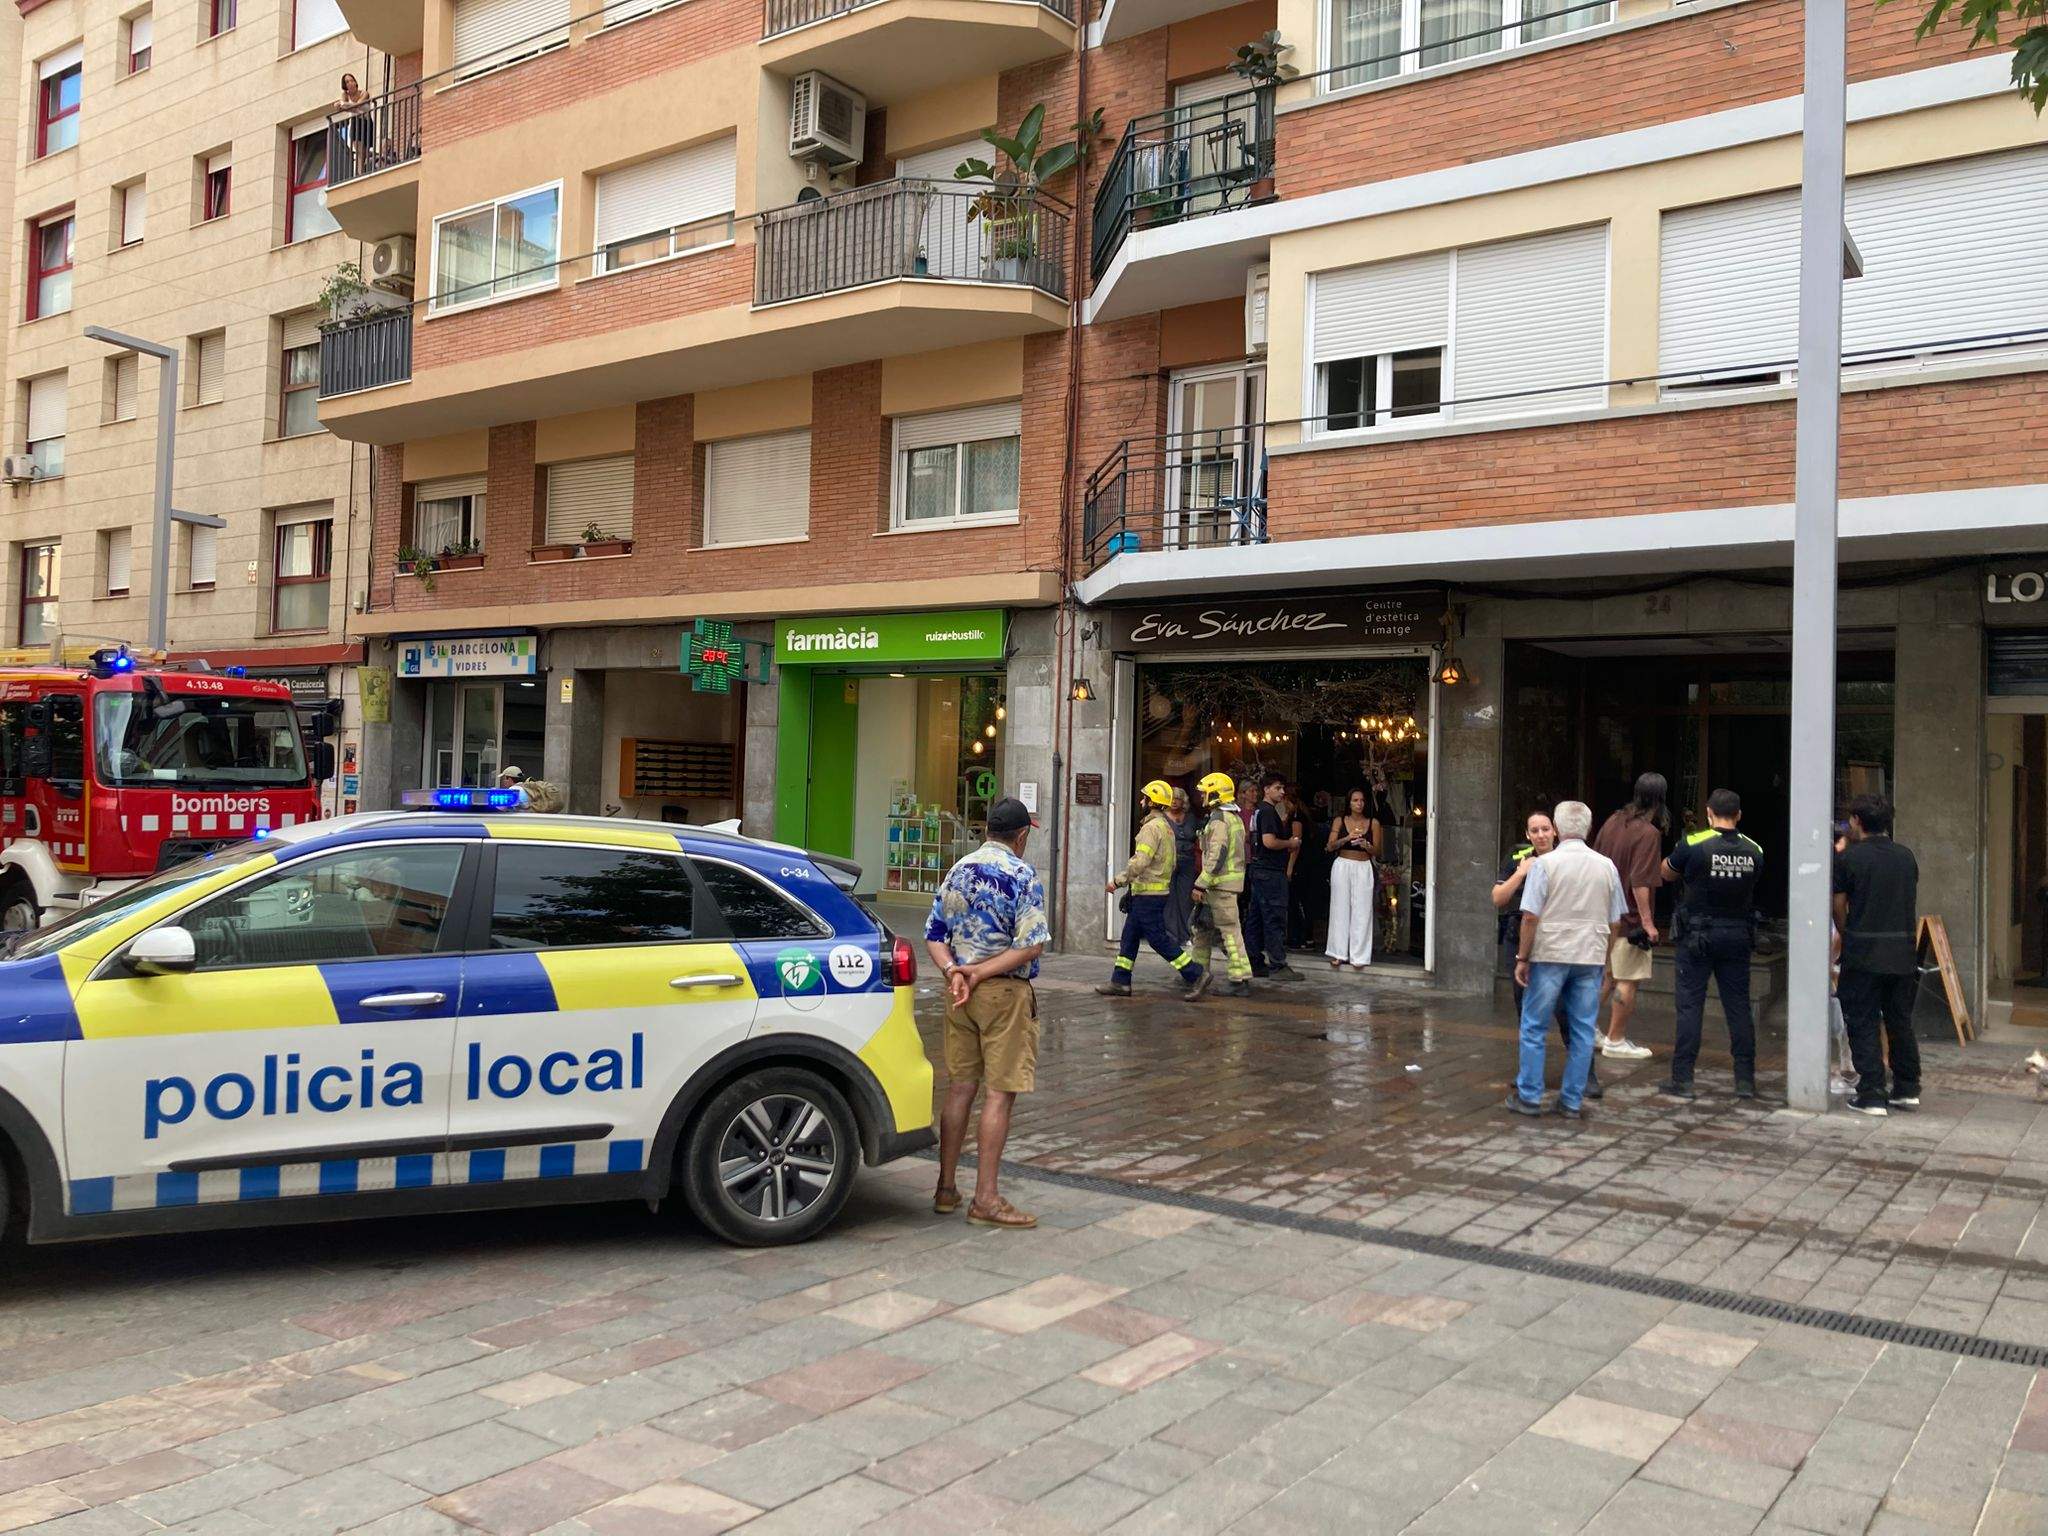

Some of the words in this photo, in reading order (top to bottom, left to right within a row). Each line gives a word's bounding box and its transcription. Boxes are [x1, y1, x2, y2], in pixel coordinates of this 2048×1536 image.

[1987, 571, 2048, 603] LO
[1365, 600, 1402, 610] Centre
[1130, 613, 1189, 642] Eva
[1192, 608, 1348, 640] Sánchez
[786, 626, 879, 652] farmàcia
[429, 644, 446, 656] GIL
[451, 641, 516, 656] BARCELONA
[455, 661, 487, 672] VIDRES
[186, 680, 224, 691] 4.13.48
[172, 793, 270, 813] bombers
[1712, 854, 1754, 866] POLICIA
[780, 867, 810, 878] C-34
[836, 954, 865, 968] 112
[143, 1048, 424, 1140] policia
[467, 1031, 645, 1101] local
